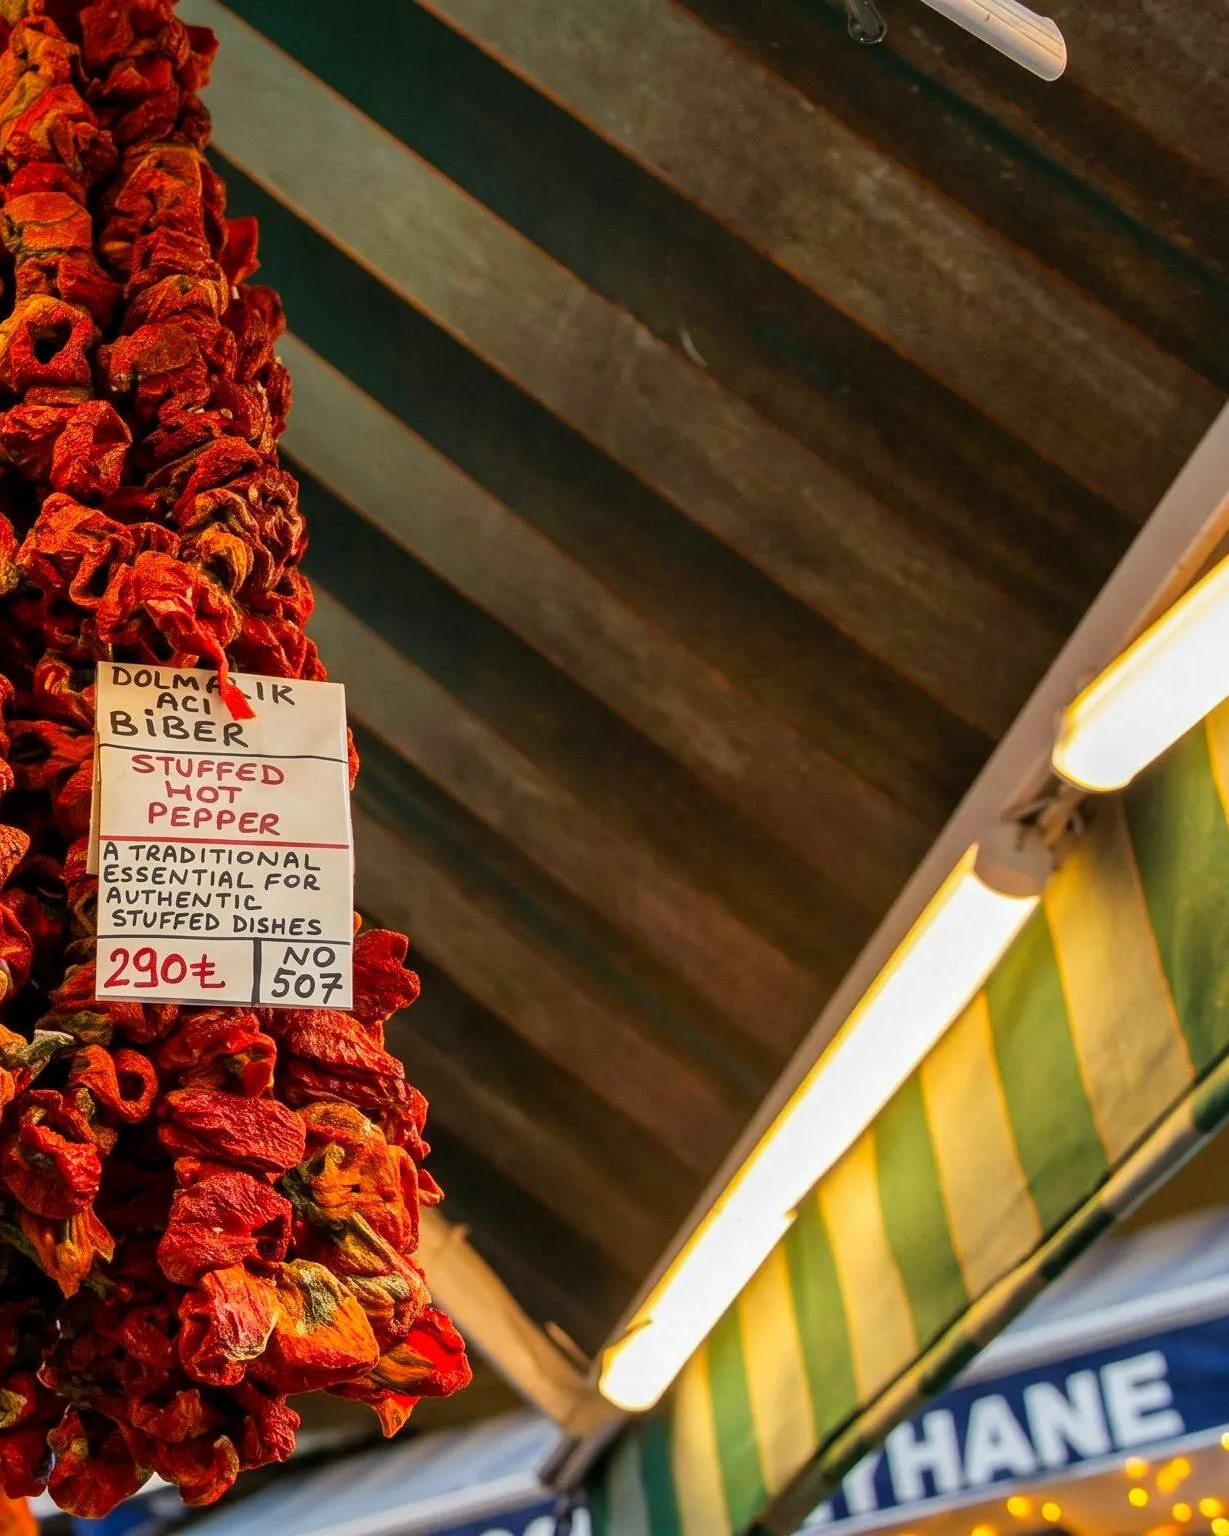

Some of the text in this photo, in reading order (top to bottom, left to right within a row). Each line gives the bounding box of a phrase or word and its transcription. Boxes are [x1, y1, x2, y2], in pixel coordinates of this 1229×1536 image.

[111, 666, 295, 706] DOLMAIK
[156, 691, 211, 715] ACI
[131, 754, 285, 785] STUFFED
[165, 780, 243, 804] HOT
[148, 802, 281, 836] PEPPER
[102, 841, 321, 871] A TRADITIONAL
[103, 864, 321, 891] ESSENTIAL FOR
[105, 886, 263, 911] AUTHENTIC
[111, 909, 322, 936] STUFFED DISHES
[282, 946, 336, 968] NO
[270, 969, 343, 1005] 507
